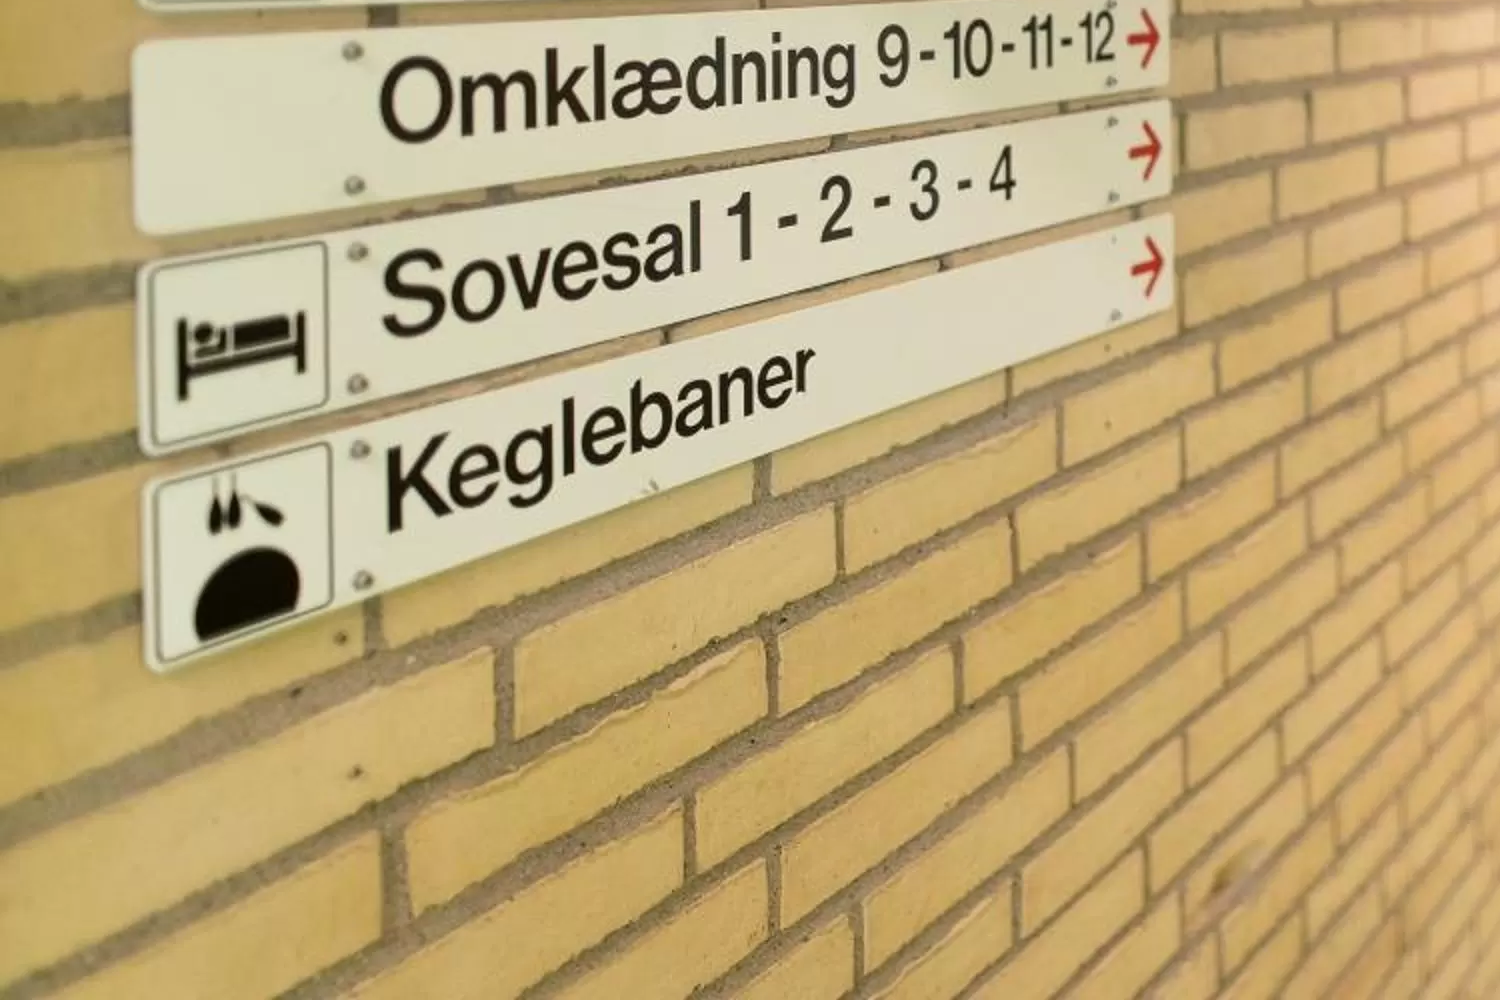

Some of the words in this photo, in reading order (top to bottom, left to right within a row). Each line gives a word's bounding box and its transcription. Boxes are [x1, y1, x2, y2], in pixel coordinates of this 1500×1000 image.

[379, 30, 856, 145] Omklædning
[382, 198, 702, 339] Sovesal
[726, 190, 753, 262] 1
[819, 174, 854, 244] 2
[908, 158, 941, 222] 3
[988, 144, 1018, 202] 4
[386, 347, 817, 535] Keglebaner
